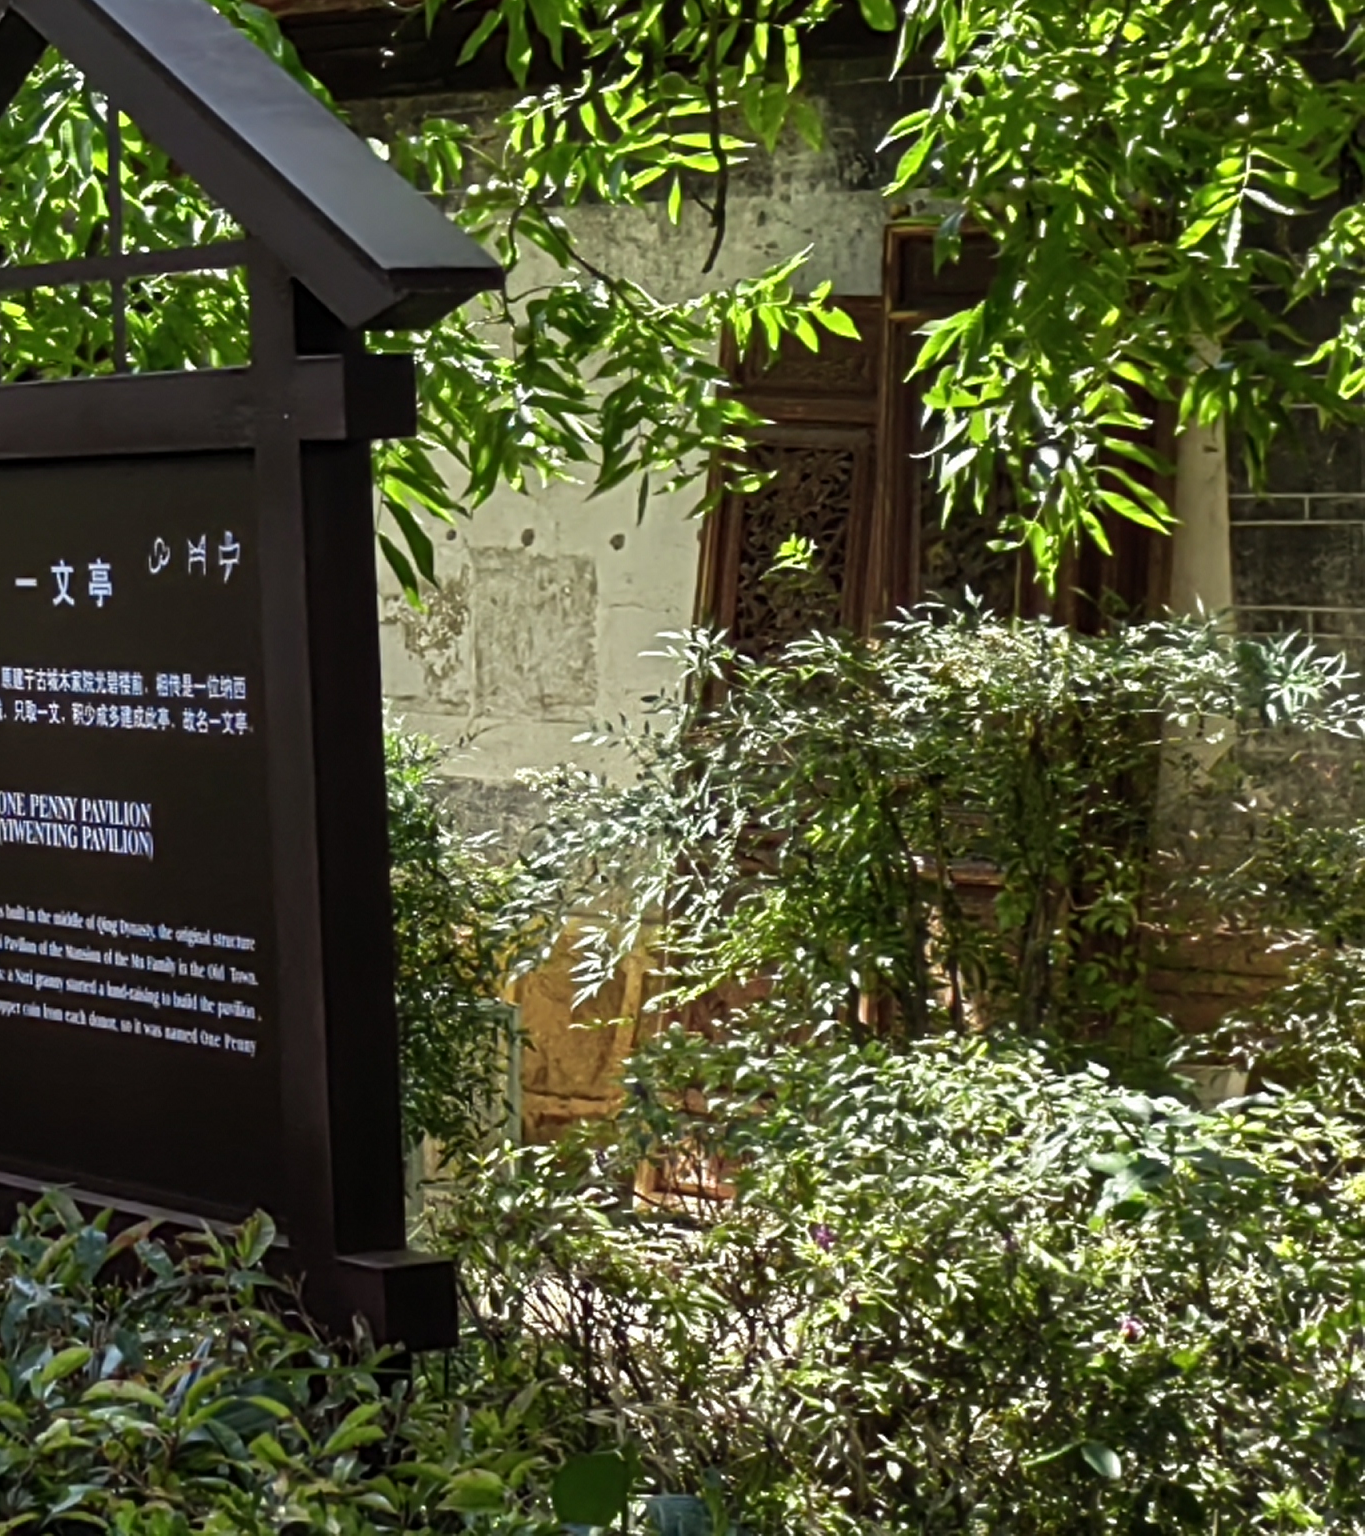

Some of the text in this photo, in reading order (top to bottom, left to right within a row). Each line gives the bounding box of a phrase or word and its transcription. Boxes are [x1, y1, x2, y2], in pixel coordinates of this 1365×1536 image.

[15, 558, 112, 607] 一文亭
[30, 794, 78, 821] PENNY
[81, 798, 152, 828] PAVILION
[82, 826, 154, 862] PAVILION)
